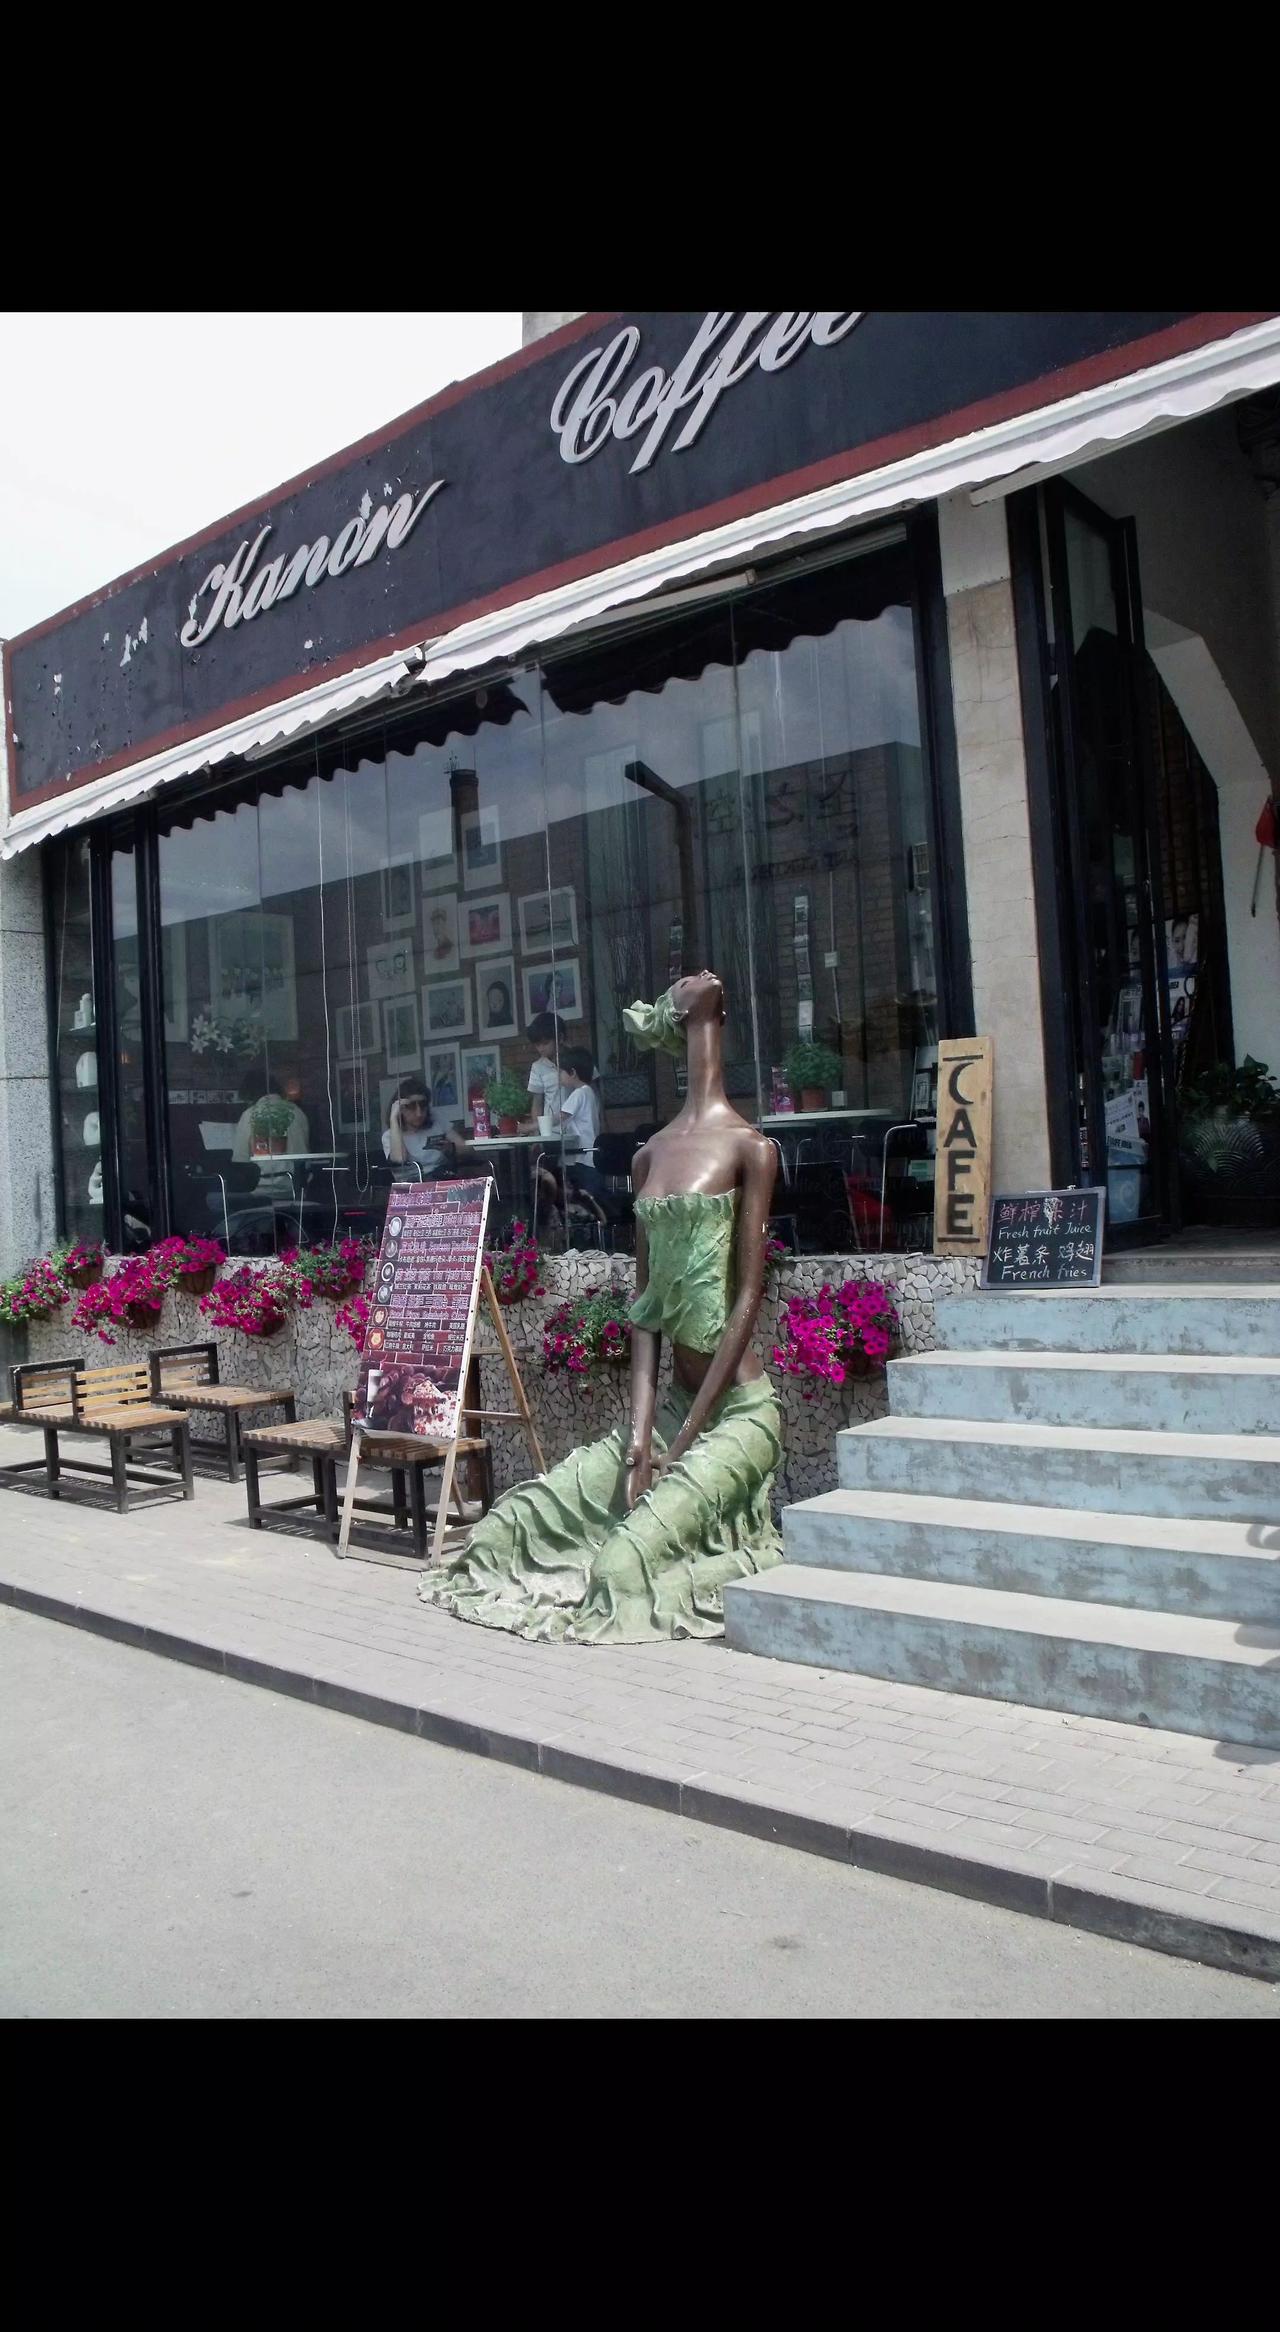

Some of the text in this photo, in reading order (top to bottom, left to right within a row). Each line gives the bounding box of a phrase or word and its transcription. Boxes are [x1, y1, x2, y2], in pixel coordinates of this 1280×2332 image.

[180, 479, 447, 648] Kanon
[943, 1061, 977, 1236] CAFE
[998, 1226, 1029, 1240] Fresh
[1033, 1225, 1061, 1238] fruit
[992, 1243, 1050, 1266] 炸薯条
[1001, 1264, 1087, 1280] French fries
